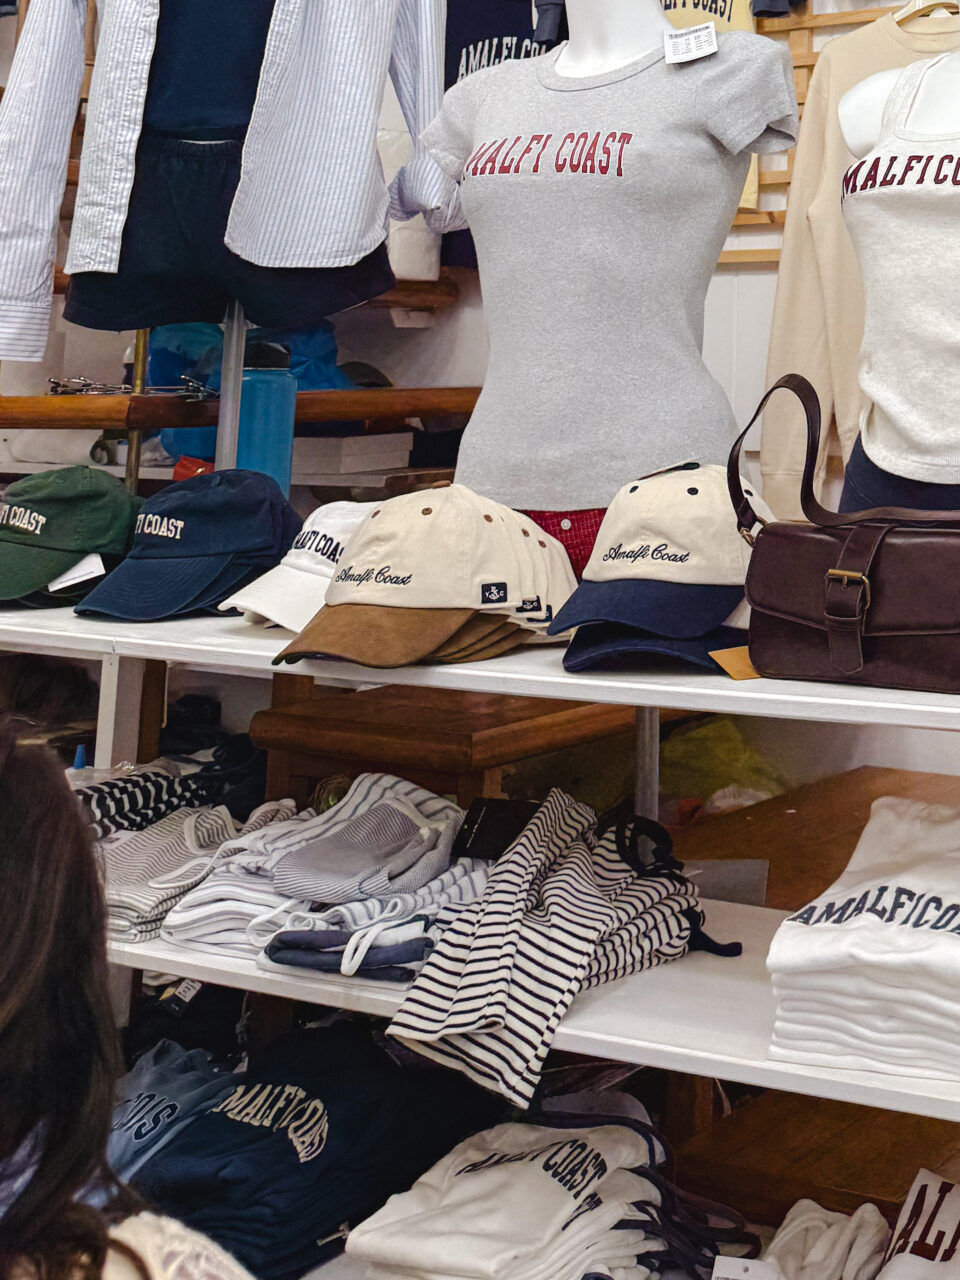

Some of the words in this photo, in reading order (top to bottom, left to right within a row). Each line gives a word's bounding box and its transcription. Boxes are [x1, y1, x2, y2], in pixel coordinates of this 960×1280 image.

[464, 133, 553, 178] MALFI
[554, 131, 633, 177] COAST
[841, 154, 935, 205] MALFI
[9, 505, 47, 535] COAST
[143, 513, 185, 540] COAST
[602, 542, 651, 564] Amalfi
[651, 543, 690, 563] Coast
[335, 565, 375, 587] Amalfi
[374, 565, 413, 586] Coast
[787, 885, 927, 927] AMALFI
[210, 1083, 307, 1133] MALFI
[541, 1138, 608, 1200] COAST
